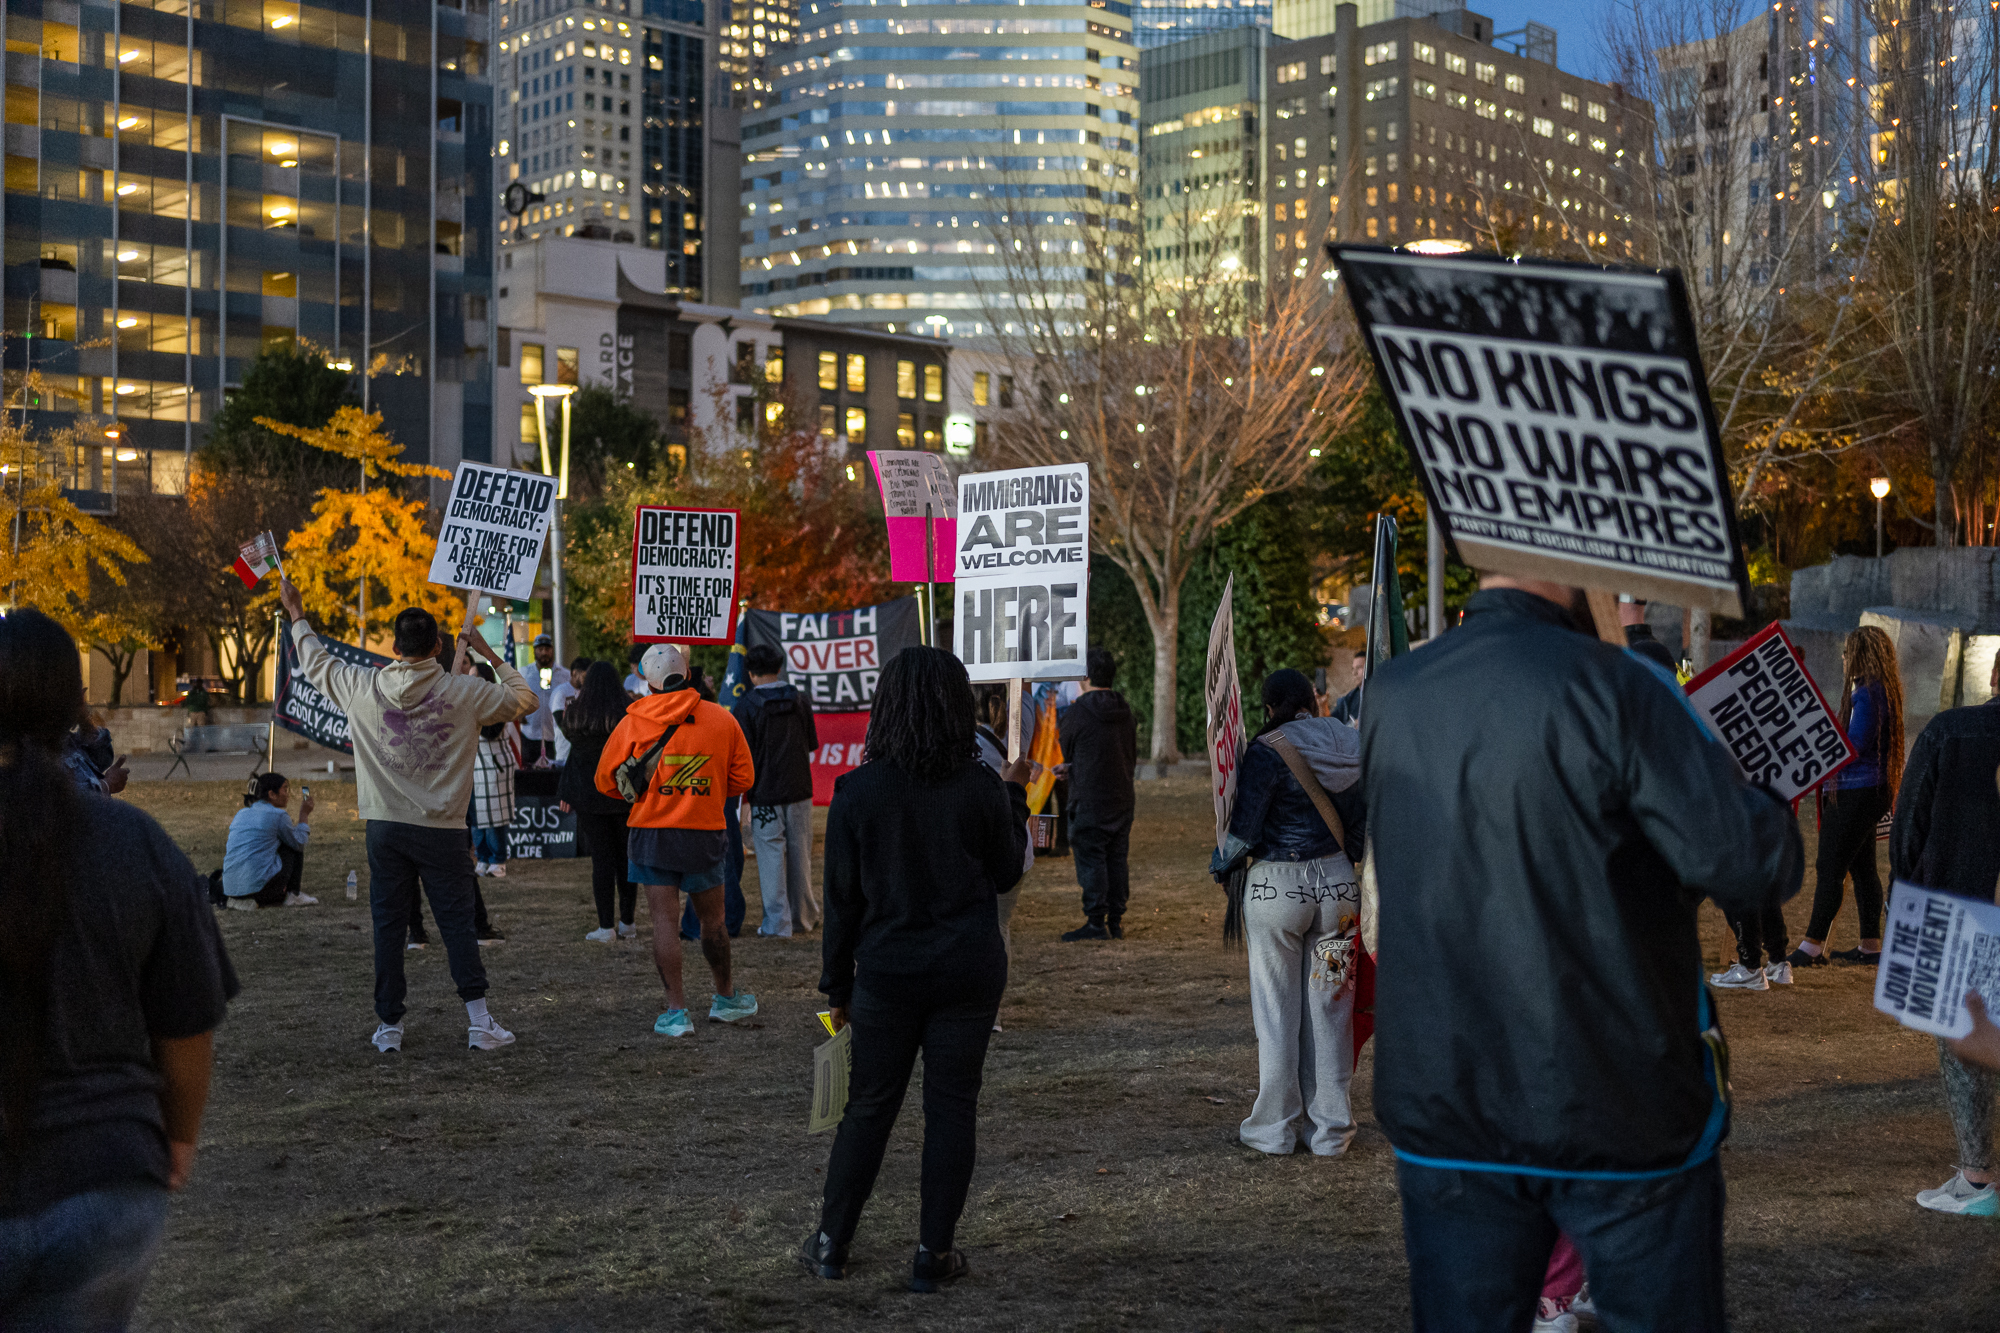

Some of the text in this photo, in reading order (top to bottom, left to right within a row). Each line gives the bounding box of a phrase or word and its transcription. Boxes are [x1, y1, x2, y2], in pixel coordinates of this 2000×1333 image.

[1381, 335, 1699, 433] NO KINGS
[1410, 407, 1715, 506] NO WARS
[456, 468, 553, 513] DEFEND
[963, 472, 1083, 513] IMMIGRANTS
[450, 499, 544, 533] DEMOCRACY:
[1432, 466, 1727, 555] NO EMPIRES
[443, 524, 539, 559] IT'S TIME FOR
[642, 511, 733, 548] DEFEND
[960, 507, 1083, 552] ARE
[447, 544, 521, 575] A GENERAL
[639, 545, 732, 570] DEMOCRACY:
[961, 547, 1083, 569] WELCOME
[1499, 523, 1532, 543] FOR
[1531, 528, 1618, 559] SOCIALISM
[1633, 547, 1730, 580] LIBERATION
[453, 564, 510, 591] STRIKE!
[638, 574, 732, 598] IT'S TIME FOR
[647, 595, 721, 618] A GENERAL
[780, 605, 877, 640] FAITH
[963, 583, 1078, 664] HERE
[656, 615, 711, 637] STRIKE!
[788, 639, 877, 671] OVER
[788, 670, 880, 703] FEAR
[1757, 635, 1847, 769] MONEY FOR
[286, 698, 324, 729] GODLY
[1727, 653, 1822, 788] PEOPLE'S
[819, 743, 844, 765] IS
[1708, 693, 1783, 789] NEEDS
[658, 785, 711, 796] GYM
[517, 845, 542, 858] LIFE
[1251, 877, 1278, 902] ED
[1883, 920, 1920, 1011] JOIN THE
[1907, 898, 1953, 1020] MOVEMENT!
